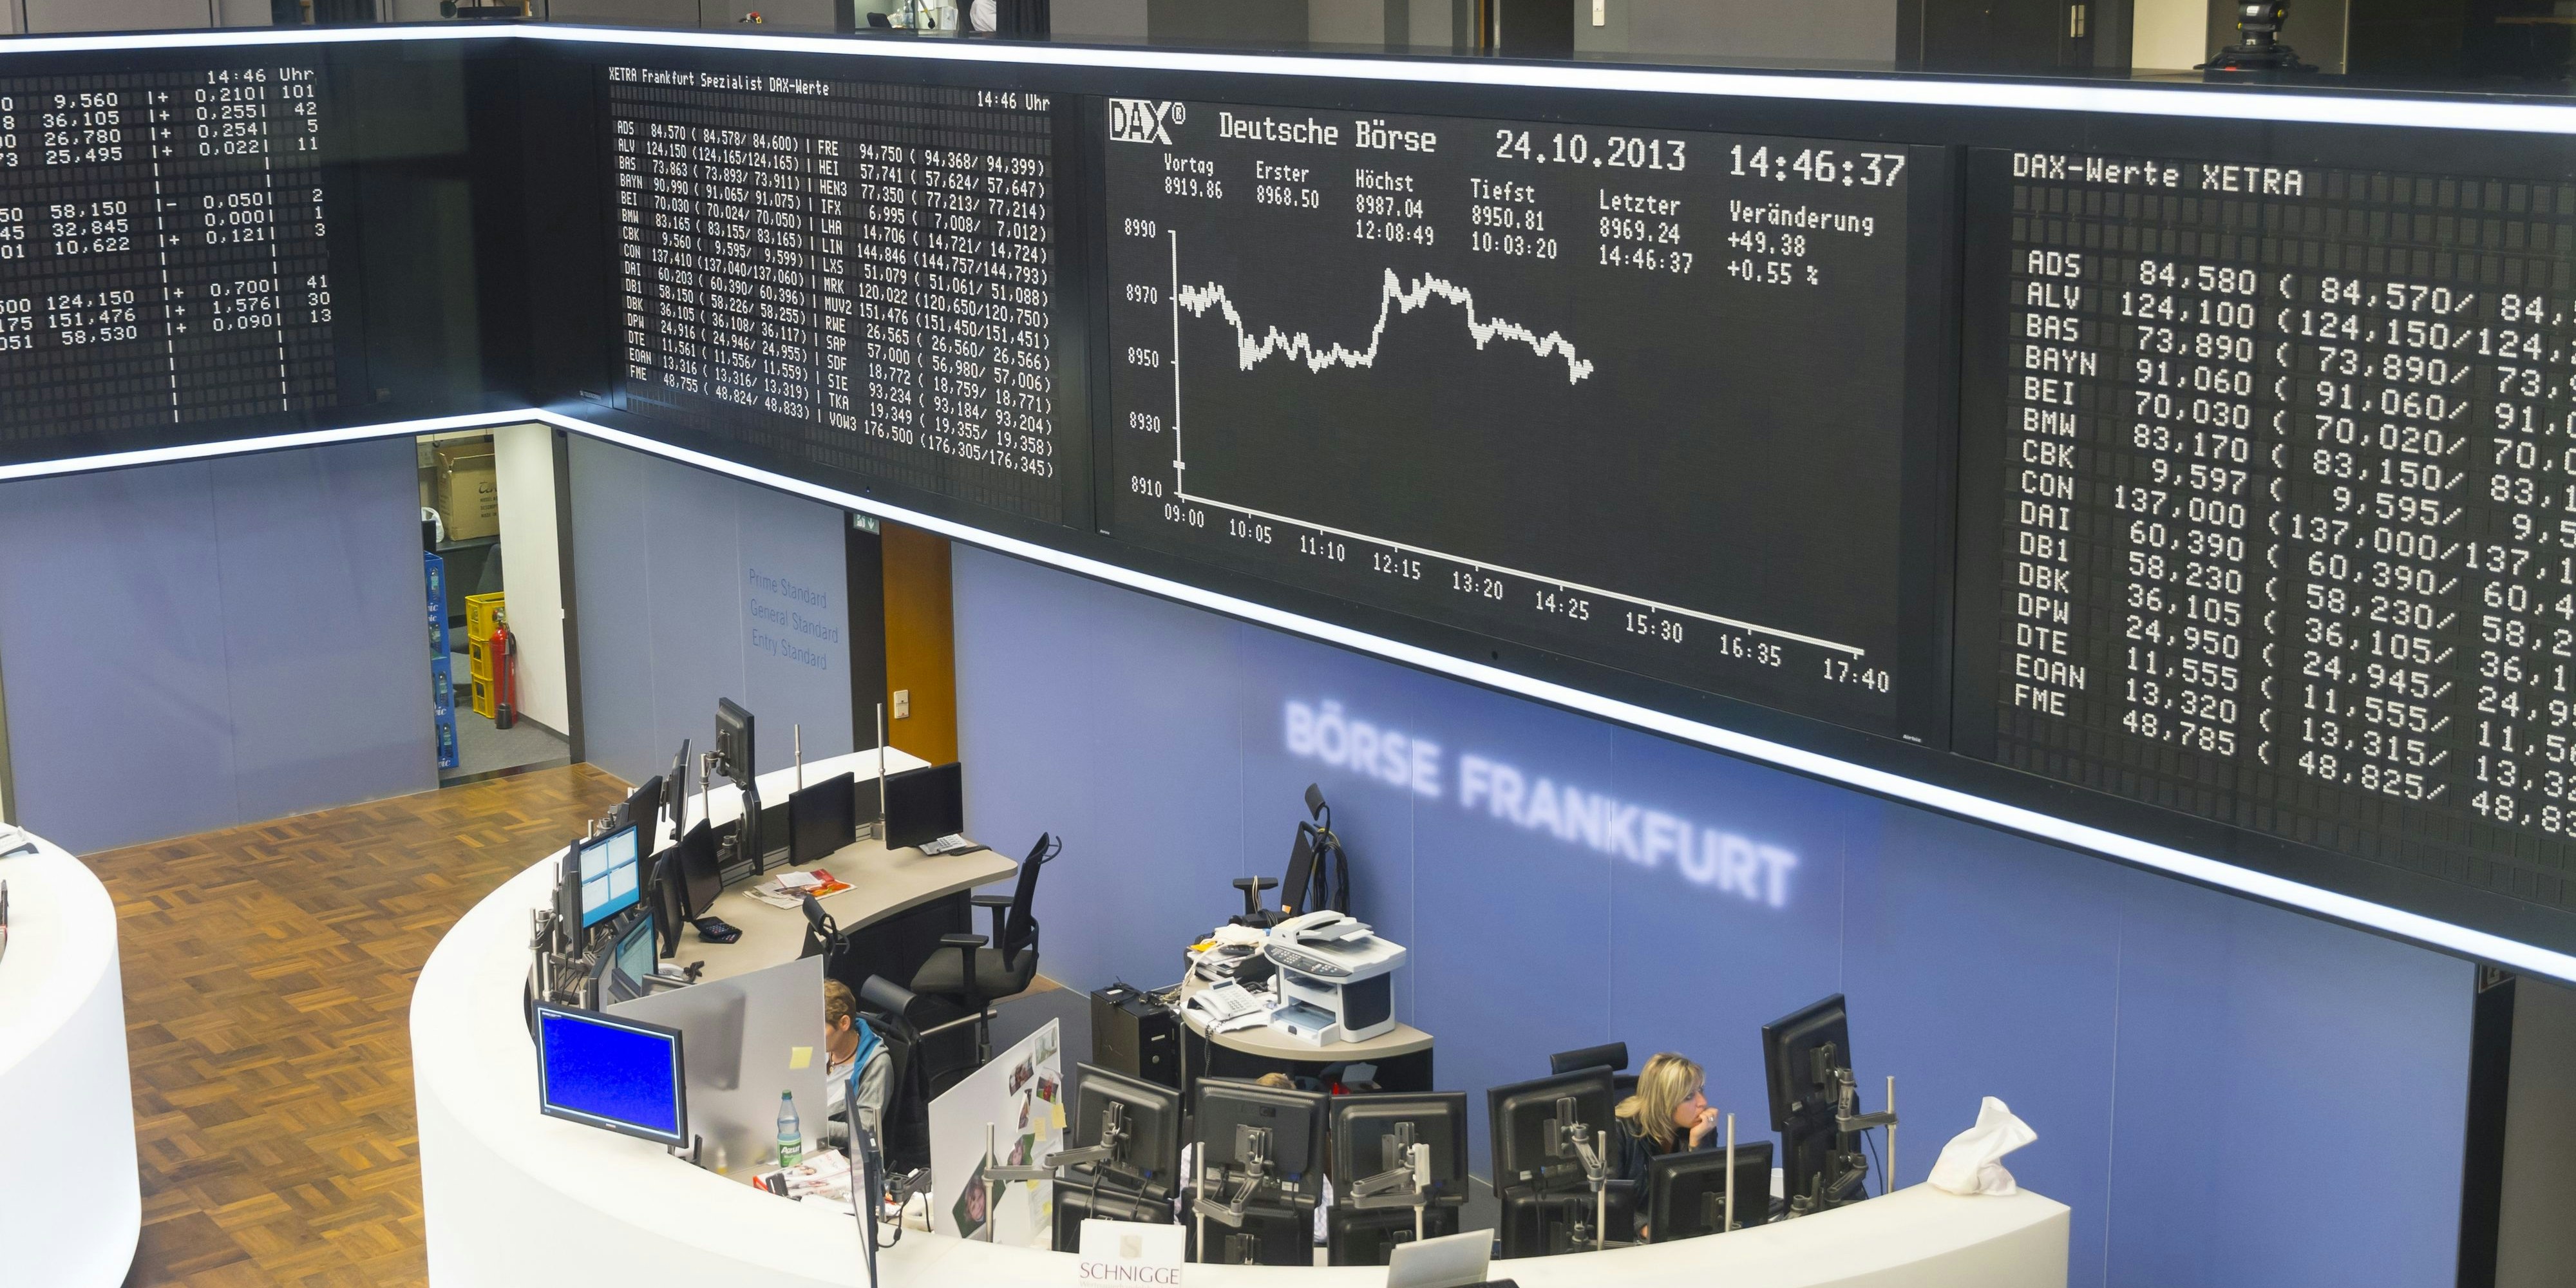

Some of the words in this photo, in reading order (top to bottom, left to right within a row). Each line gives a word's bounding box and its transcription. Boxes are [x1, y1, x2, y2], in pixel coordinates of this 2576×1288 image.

[53, 91, 118, 109] 9,560
[281, 84, 315, 99] 101
[207, 68, 267, 85] 14:46
[279, 66, 315, 82] Uhr
[608, 66, 638, 82] XETRA
[641, 68, 695, 86] Frankfurt
[700, 71, 763, 91] Spezialist
[768, 76, 830, 97] DAX-Werte
[42, 110, 120, 129] 36,105
[294, 100, 317, 117] 42
[977, 90, 1018, 109] 14:46
[1025, 93, 1051, 112] Uhr
[44, 128, 122, 147] 26,780
[45, 146, 123, 166] 25,495
[298, 136, 318, 151] 11
[616, 119, 635, 136] ADS
[650, 122, 687, 141] 84,570
[817, 138, 839, 157] FRE
[617, 137, 636, 153] ALV
[818, 158, 839, 176] HEI
[1218, 111, 1339, 146] Deutsche
[1354, 118, 1437, 153] Börse
[1496, 129, 1685, 171] 24.10.2013
[1730, 144, 1905, 187] 14:46:37
[618, 155, 637, 171] BAS
[652, 158, 688, 178] 73,863
[819, 178, 848, 198] HEN3
[619, 172, 643, 190] BAYN
[820, 198, 842, 216] IFX
[1164, 152, 1214, 177] Vortag
[1256, 160, 1310, 184] Erster
[1355, 168, 1414, 193] Höchst
[1470, 177, 1535, 204] Tiefst
[1600, 188, 1681, 216] Letzter
[1730, 200, 1874, 238] Veränderung
[2013, 153, 2179, 187] DAX-Werte
[2202, 164, 2303, 196] XETRA
[50, 200, 128, 220] 58,150
[52, 218, 129, 238] 32,845
[620, 190, 638, 207] BEI
[654, 194, 690, 214] 70,030
[820, 218, 843, 236] LHA
[621, 207, 639, 224] BMW
[821, 236, 844, 256] LIN
[1124, 217, 1157, 239] 8990
[1164, 175, 1223, 200] 8919.86
[1256, 184, 1320, 209] 8968.50
[1356, 193, 1424, 219] 8987.04
[1472, 204, 1544, 232] 8950.81
[1600, 216, 1681, 245] 8969.24
[1727, 230, 1806, 258] +49.38
[55, 236, 131, 256] 10,622
[622, 225, 640, 242] CBK
[661, 231, 692, 251] 9,560
[822, 256, 844, 275] LXS
[623, 243, 641, 260] CON
[823, 276, 845, 295] MRK
[1356, 218, 1434, 246] 12:08:49
[1472, 231, 1557, 260] 10:03:20
[1600, 243, 1693, 274] 14:46:37
[1727, 258, 1792, 286] +0.55
[1806, 265, 1819, 286] %
[46, 289, 135, 311] 124,150
[306, 274, 328, 289] 41
[624, 260, 641, 277] DAI
[658, 266, 694, 287] 60,203
[824, 295, 853, 316] MUV2
[1126, 283, 1158, 305] 8970
[2027, 249, 2081, 278] ADS
[2139, 260, 2257, 296] 84,580
[48, 307, 137, 329] 151,476
[307, 291, 331, 307] 30
[61, 325, 138, 346] 58,530
[310, 308, 332, 324] 13
[625, 278, 643, 294] DB1
[824, 314, 847, 334] RWE
[625, 295, 644, 312] DBK
[659, 301, 696, 322] 36,105
[826, 334, 847, 352] SAP
[2027, 281, 2080, 310] ALV
[2121, 290, 2255, 330] 124,100
[627, 312, 645, 330] DPW
[826, 353, 848, 372] SDF
[627, 329, 646, 347] DTE
[661, 336, 696, 358] 11,561
[827, 372, 849, 392] SIE
[1128, 346, 1159, 368] 8950
[2025, 312, 2079, 343] BAS
[2137, 325, 2253, 363] 73,890
[629, 346, 652, 365] EOAN
[828, 392, 849, 412] TKA
[2025, 344, 2097, 377] BAYN
[2136, 357, 2252, 397] 91,060
[629, 364, 648, 381] FME
[663, 372, 699, 393] 48,755
[828, 410, 857, 432] VOW3
[1129, 411, 1160, 433] 8930
[2024, 375, 2075, 406] BEI
[2135, 390, 2250, 430] 70,030
[2023, 406, 2076, 438] BMW
[2133, 422, 2249, 464] 83,170
[1131, 475, 1162, 498] 8910
[2022, 438, 2075, 469] CBK
[2151, 457, 2247, 496] 9,597
[2021, 469, 2074, 501] CON
[2114, 484, 2246, 529] 137,000
[2020, 500, 2070, 532] DAI
[2129, 519, 2244, 562] 60,390
[2019, 530, 2069, 563] DB1
[2128, 550, 2242, 595] 58,230
[749, 568, 778, 594] Prime
[781, 578, 827, 609] Standard
[1164, 502, 1205, 529] 09:00
[1229, 518, 1272, 545] 10:05
[1300, 535, 1345, 562] 11:10
[1373, 552, 1421, 580] 12:15
[1453, 571, 1504, 600] 13:20
[1535, 590, 1589, 621] 14:25
[1625, 611, 1683, 644] 15:30
[1720, 634, 1782, 667] 16:35
[1823, 658, 1889, 694] 17:40
[2018, 561, 2070, 594] DBK
[2127, 582, 2241, 628] 36,105
[750, 598, 789, 627] General
[792, 612, 838, 643] Standard
[2017, 592, 2069, 625] DPW
[2125, 614, 2240, 660] 24,950
[752, 628, 778, 656] Entry
[781, 638, 827, 670] Standard
[2016, 622, 2068, 656] DTE
[2127, 646, 2238, 692] 11,555
[2015, 652, 2085, 690] EOAN
[2126, 677, 2237, 724] 13,320
[2014, 683, 2067, 717] FME
[2122, 709, 2235, 757] 48,785
[1285, 699, 1444, 797] BÖRSE
[1459, 755, 1798, 908] FRANKFURT
[1080, 1262, 1179, 1285] SCHNIGGE
